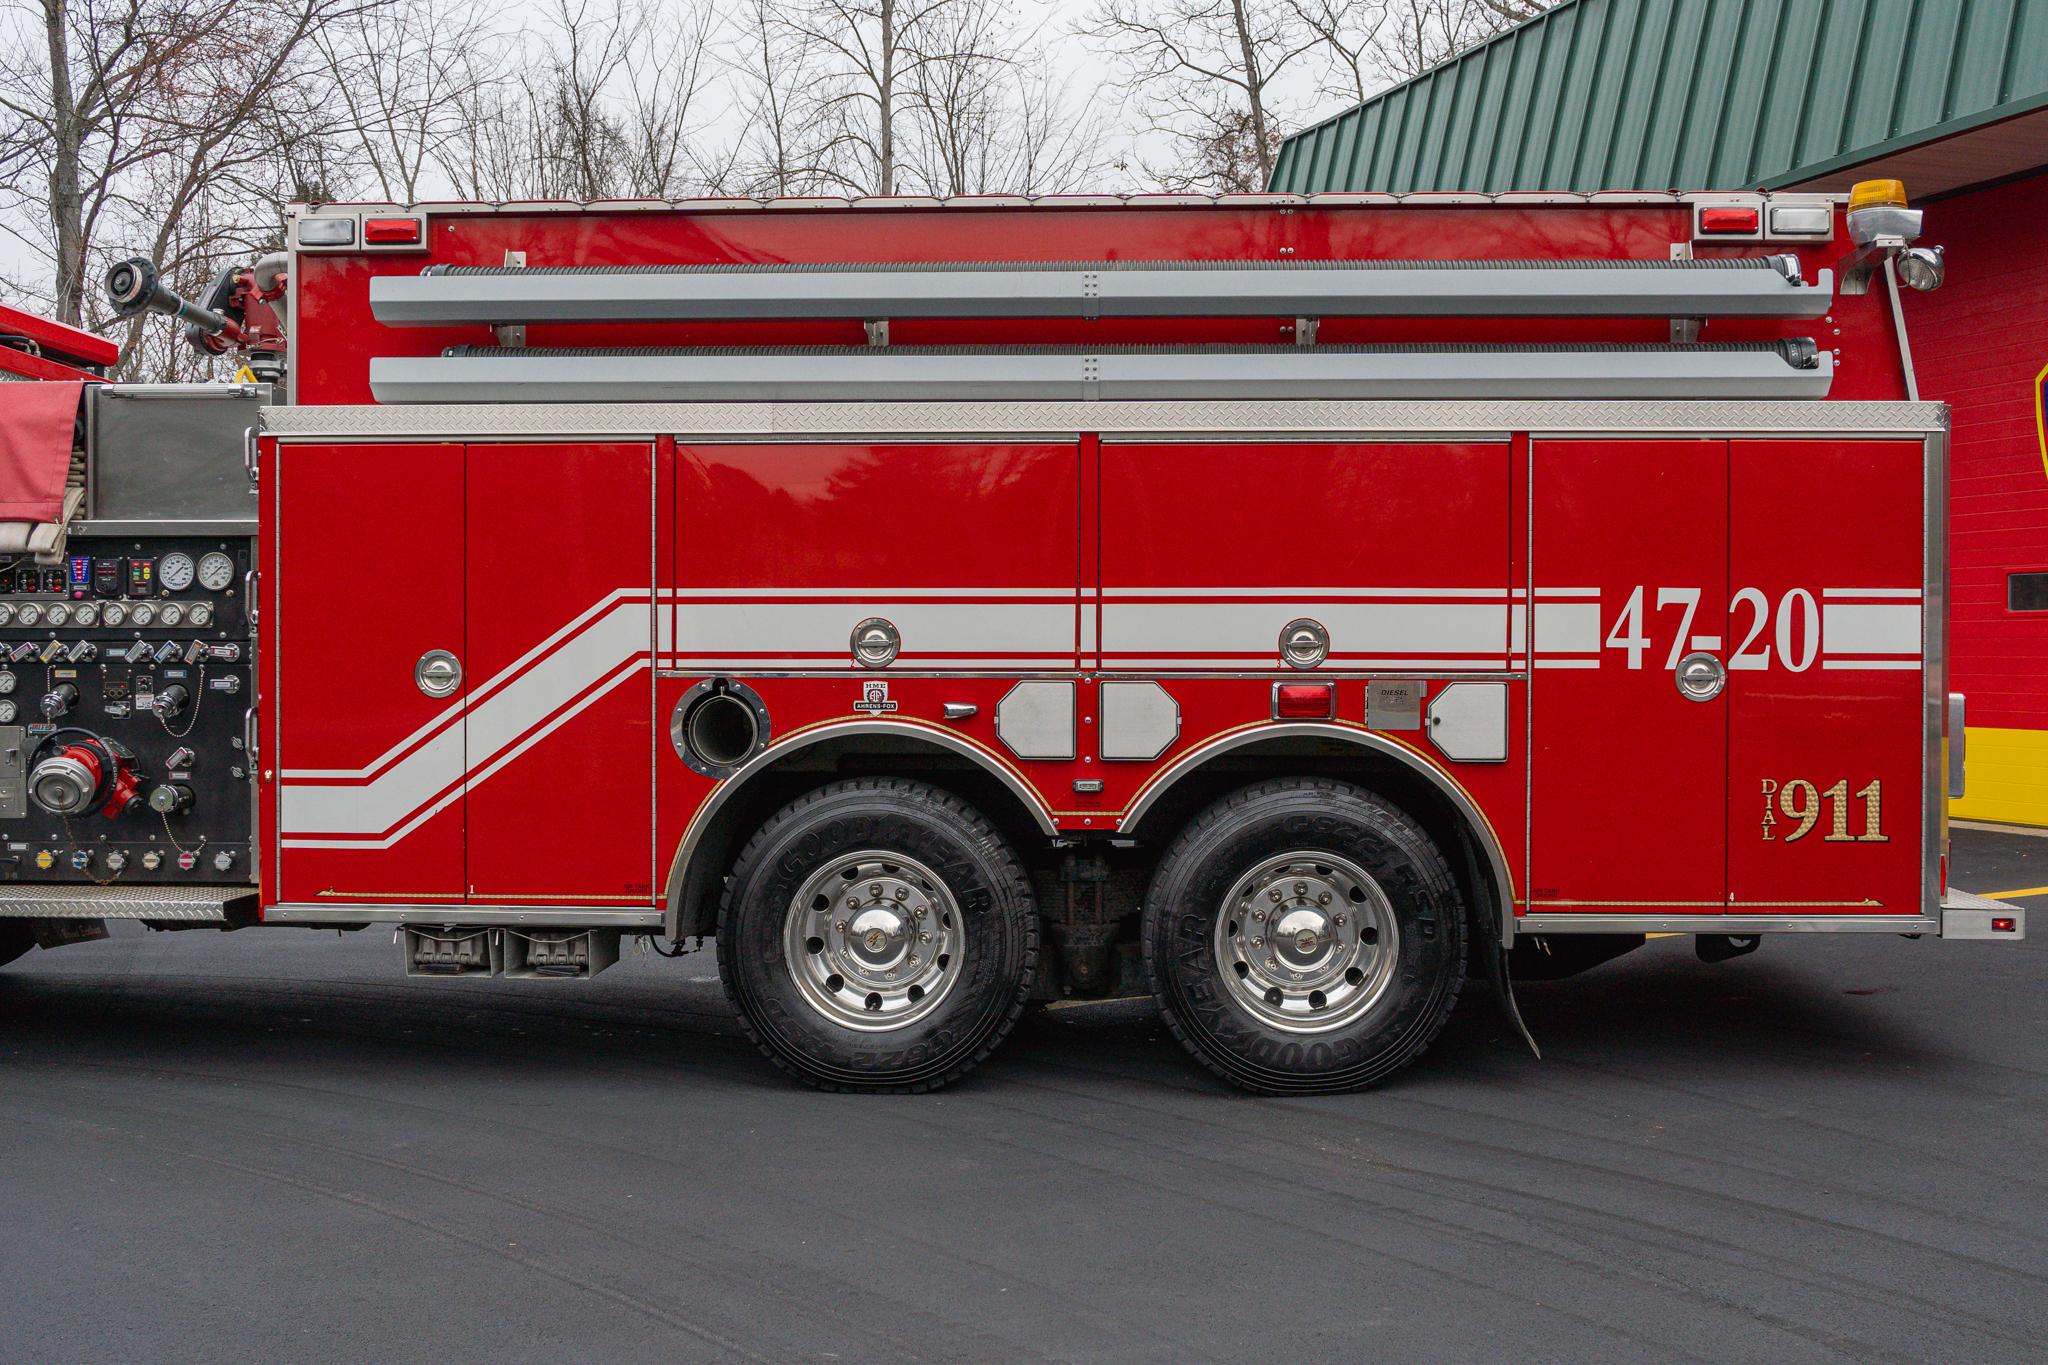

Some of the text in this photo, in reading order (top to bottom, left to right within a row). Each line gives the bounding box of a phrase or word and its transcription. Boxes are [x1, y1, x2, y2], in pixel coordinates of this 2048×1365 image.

[1605, 585, 1820, 673] 47-20
[1760, 778, 1890, 843] DIAL 911
[774, 813, 994, 917] GOODYEAR
